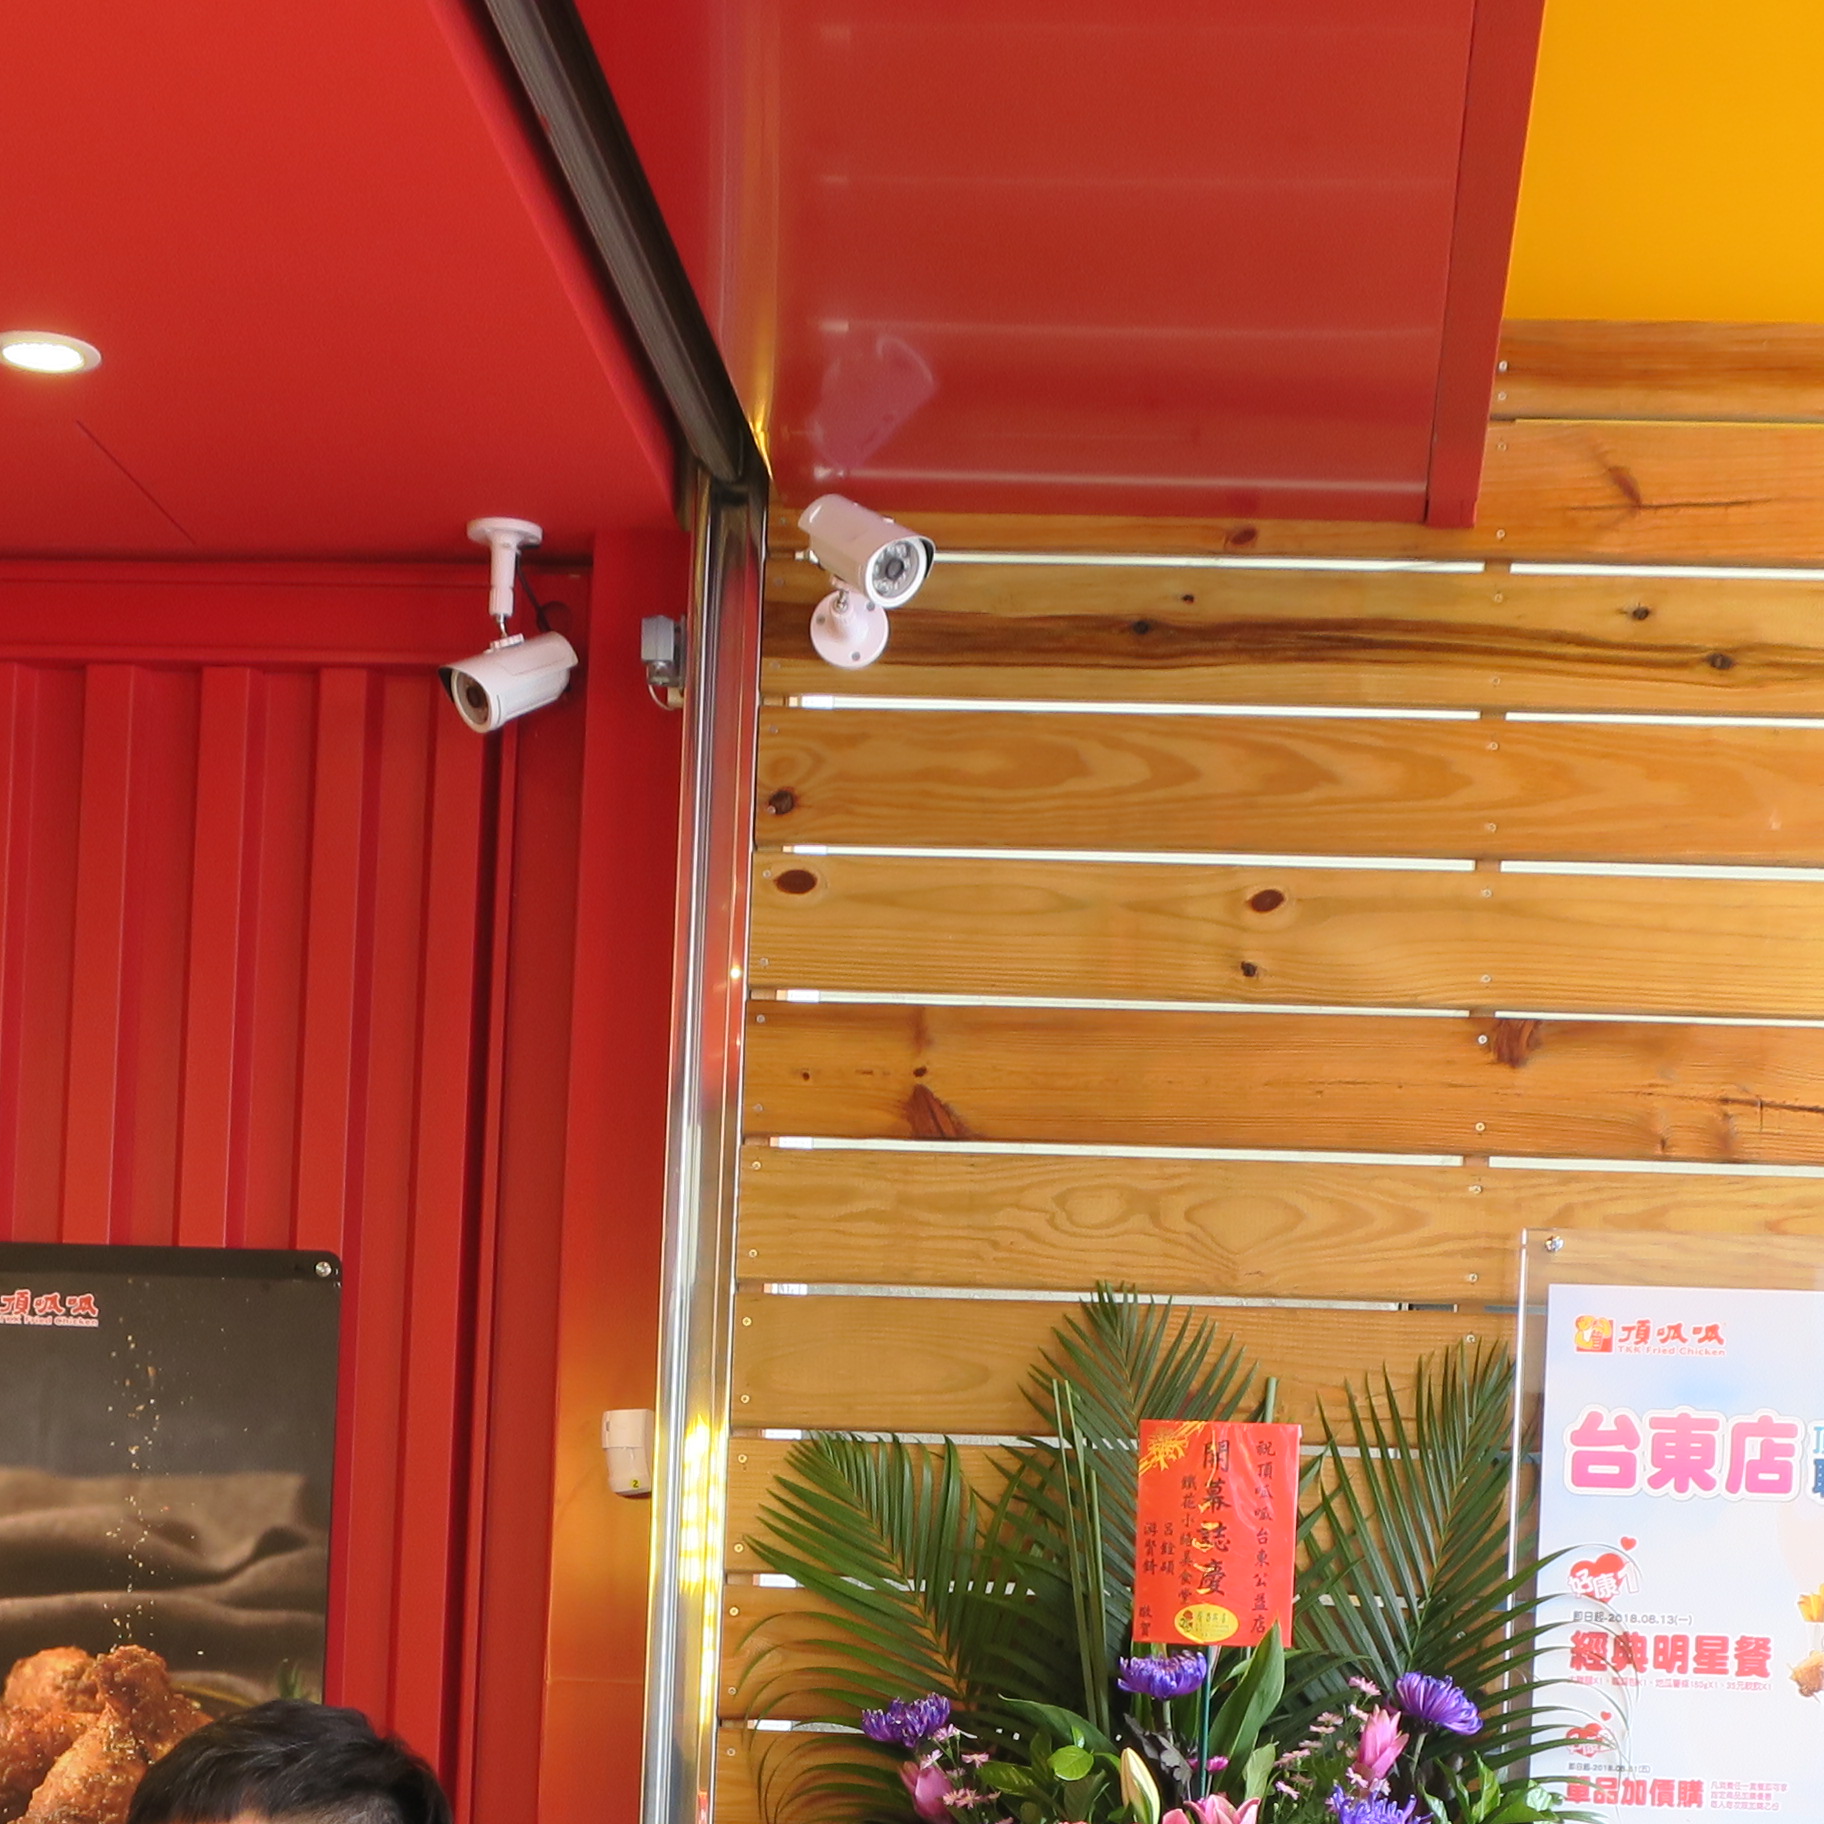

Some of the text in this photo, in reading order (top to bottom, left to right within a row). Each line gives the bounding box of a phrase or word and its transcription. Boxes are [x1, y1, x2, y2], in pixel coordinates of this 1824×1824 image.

[1618, 1319, 1725, 1346] 頂呱呱
[1618, 1345, 1725, 1356] TKK Fried Chicken
[1569, 1411, 1799, 1496] 台東店
[1570, 1630, 1772, 1679] 經典明星餐
